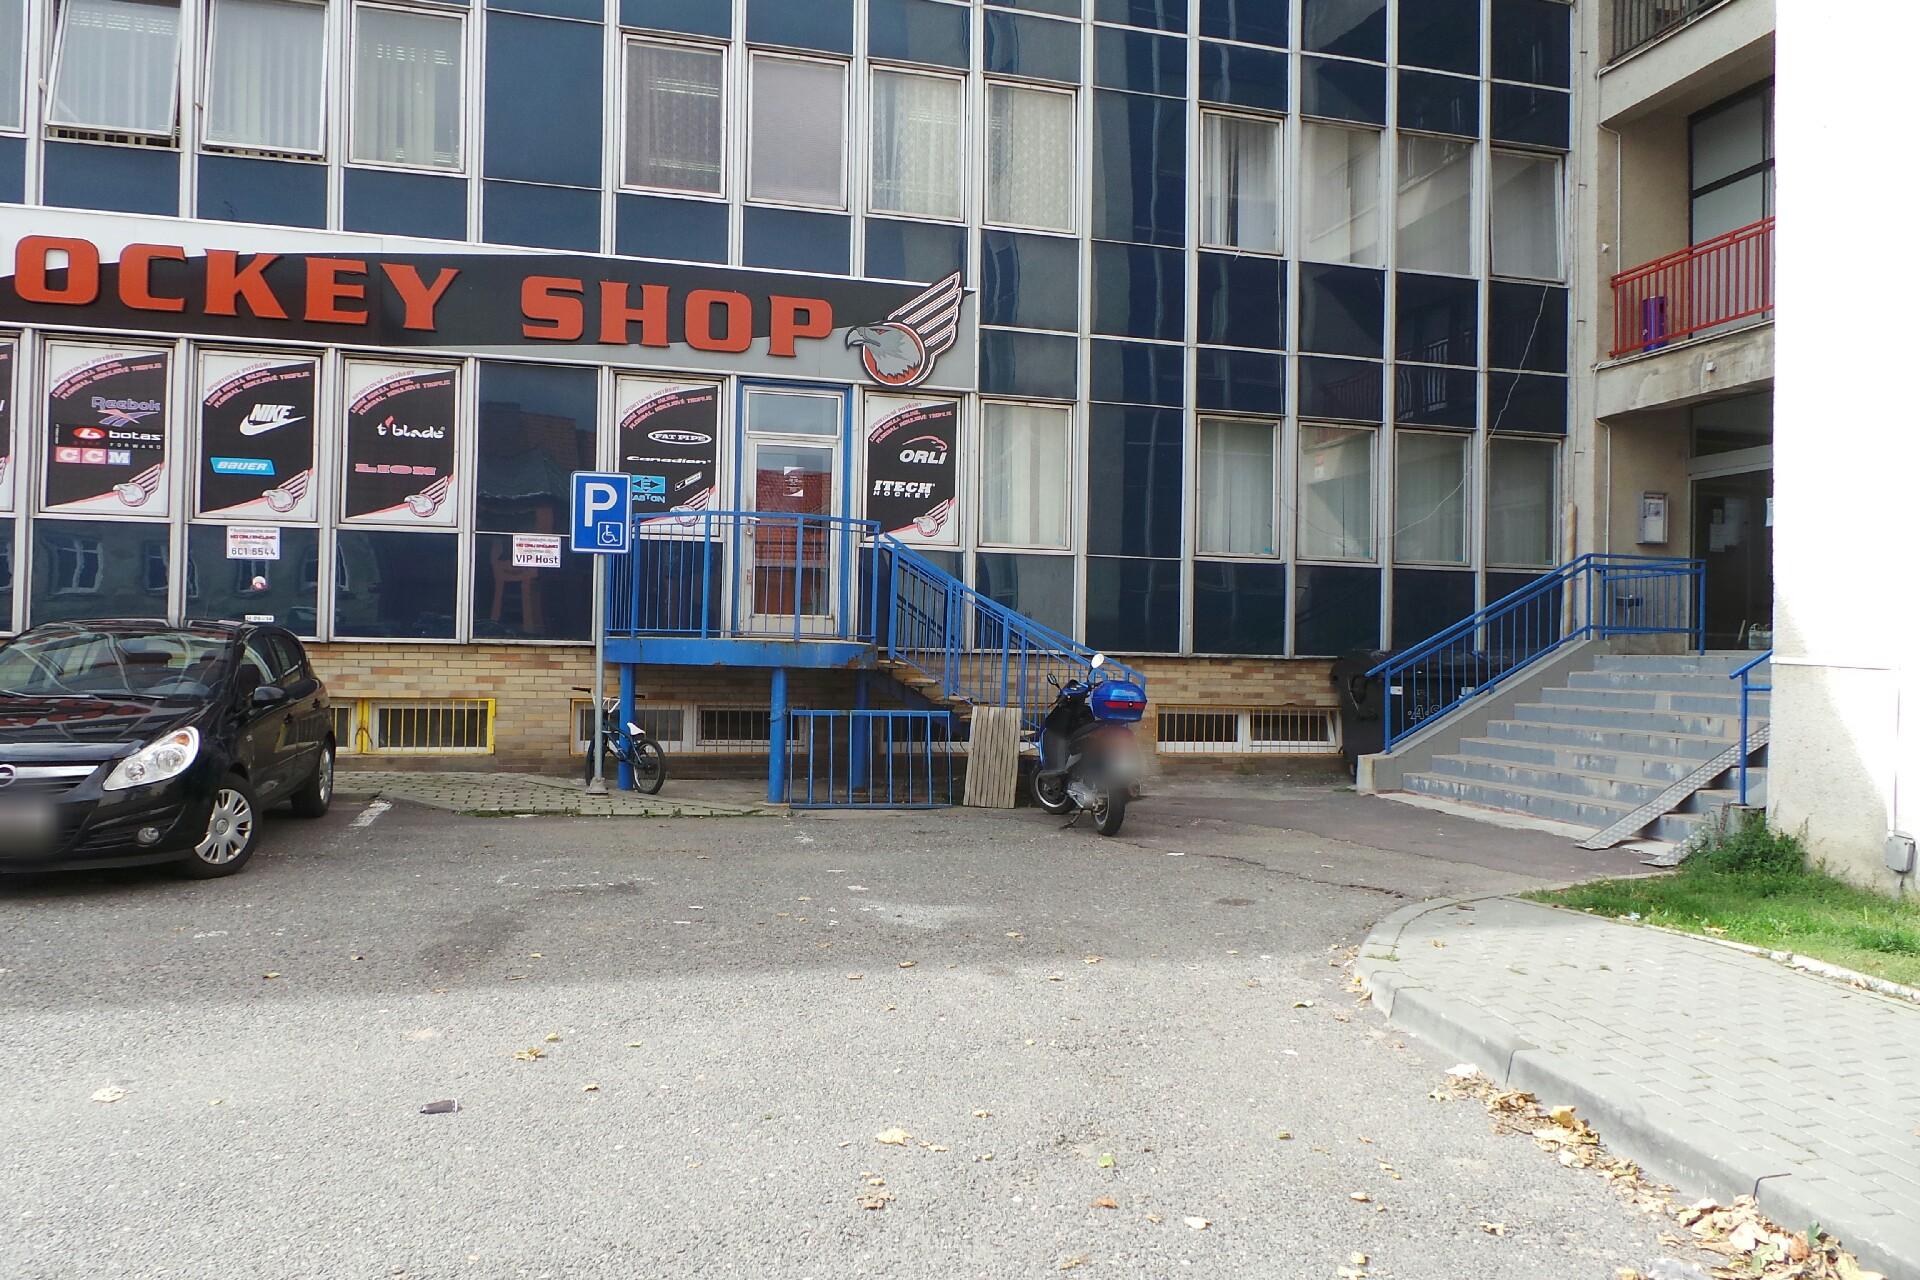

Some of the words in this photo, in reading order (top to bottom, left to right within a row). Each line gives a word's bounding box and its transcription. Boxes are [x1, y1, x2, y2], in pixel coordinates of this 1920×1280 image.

[15, 235, 460, 332] OCKEY
[520, 276, 833, 358] SHOP
[91, 396, 160, 411] Reebok
[249, 403, 296, 423] NIKE
[108, 430, 162, 441] botas
[654, 433, 677, 441] FAT
[677, 434, 706, 442] PIPE
[59, 448, 130, 464] CCM
[626, 455, 707, 465] Canadian
[899, 449, 948, 465] ORLI
[872, 489, 931, 499] HOCKEY
[873, 480, 933, 494] ITECH
[584, 482, 618, 528] P
[632, 493, 666, 504] ASTON
[515, 554, 533, 563] VIP
[535, 554, 559, 564] Host
